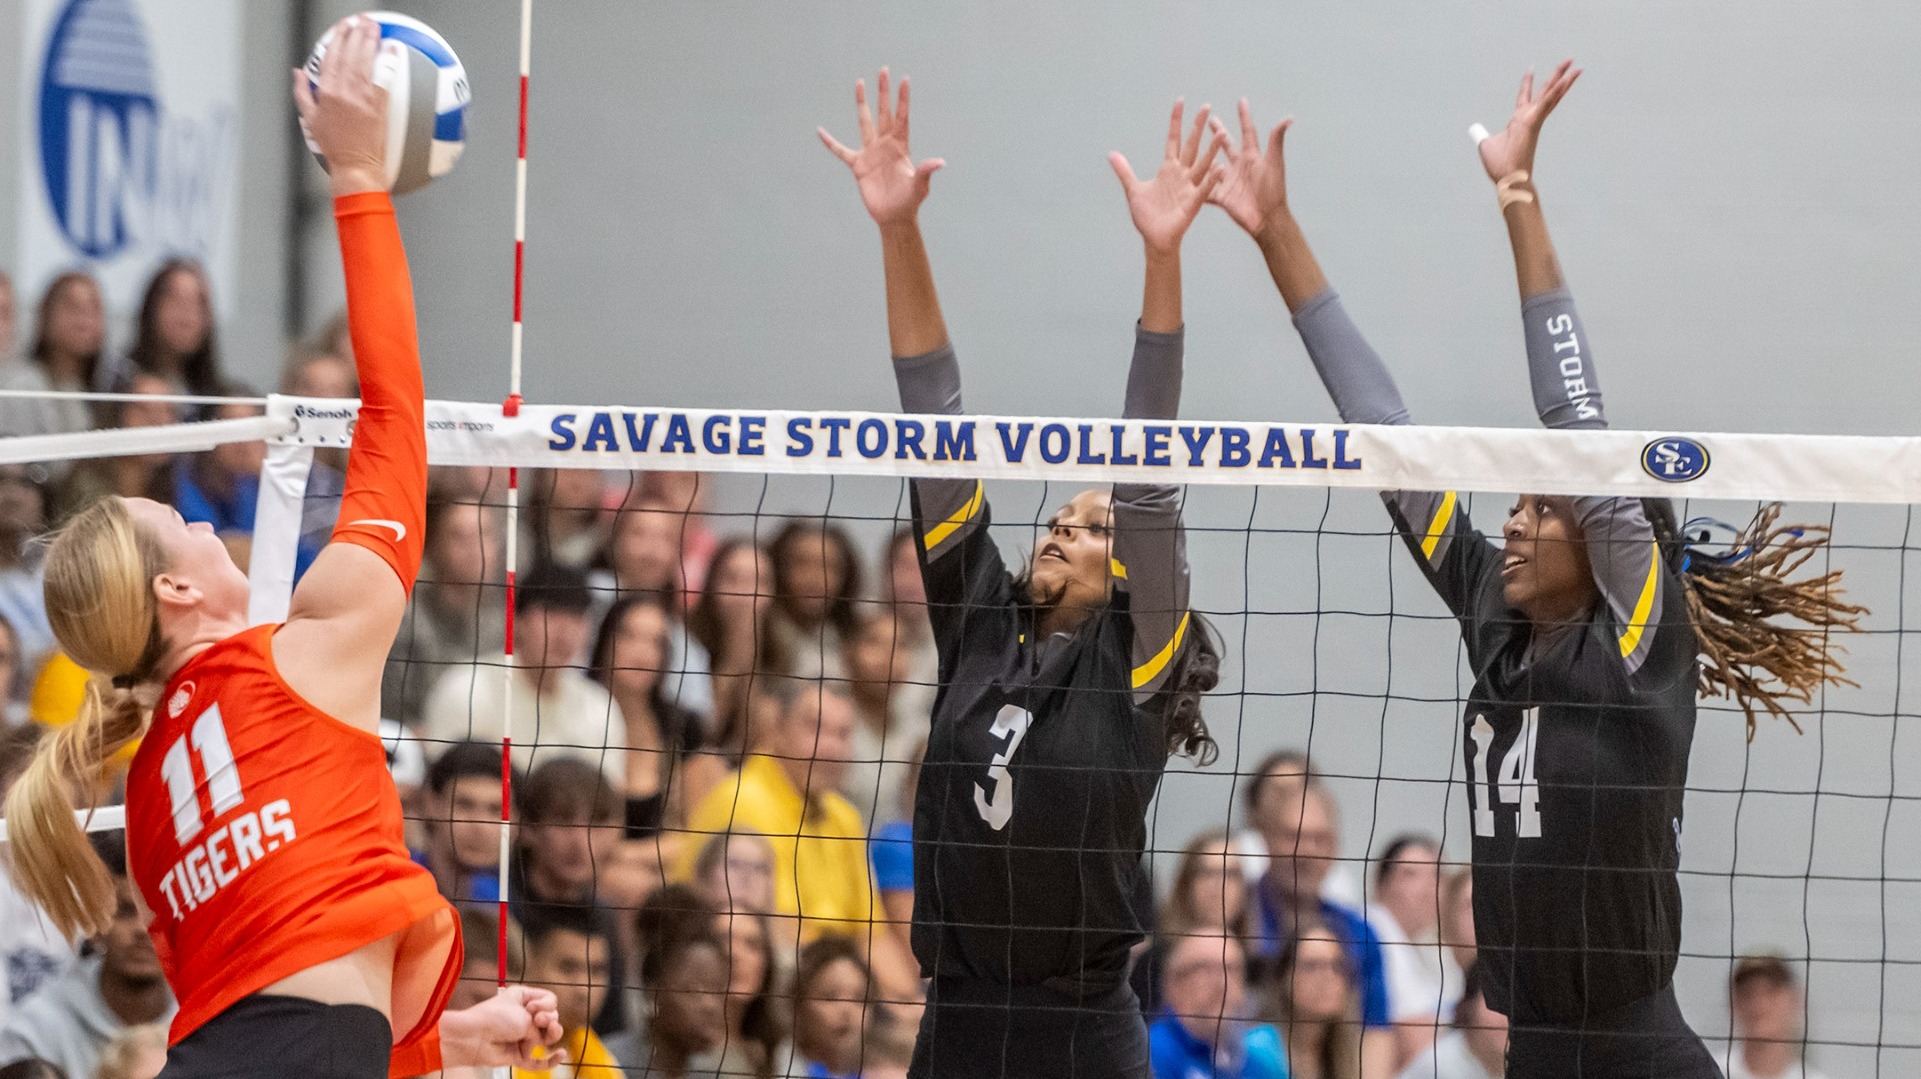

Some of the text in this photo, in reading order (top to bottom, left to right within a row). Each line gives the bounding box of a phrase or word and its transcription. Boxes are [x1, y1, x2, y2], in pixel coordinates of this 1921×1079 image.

[307, 407, 352, 418] Senoh
[1546, 313, 1599, 420] STORM
[548, 413, 1362, 470] SAVAGE STORM VOLLEYBALL
[161, 701, 245, 848] 11
[973, 703, 1034, 831] 3
[1470, 706, 1542, 838] 14
[159, 799, 297, 922] TIGERS
